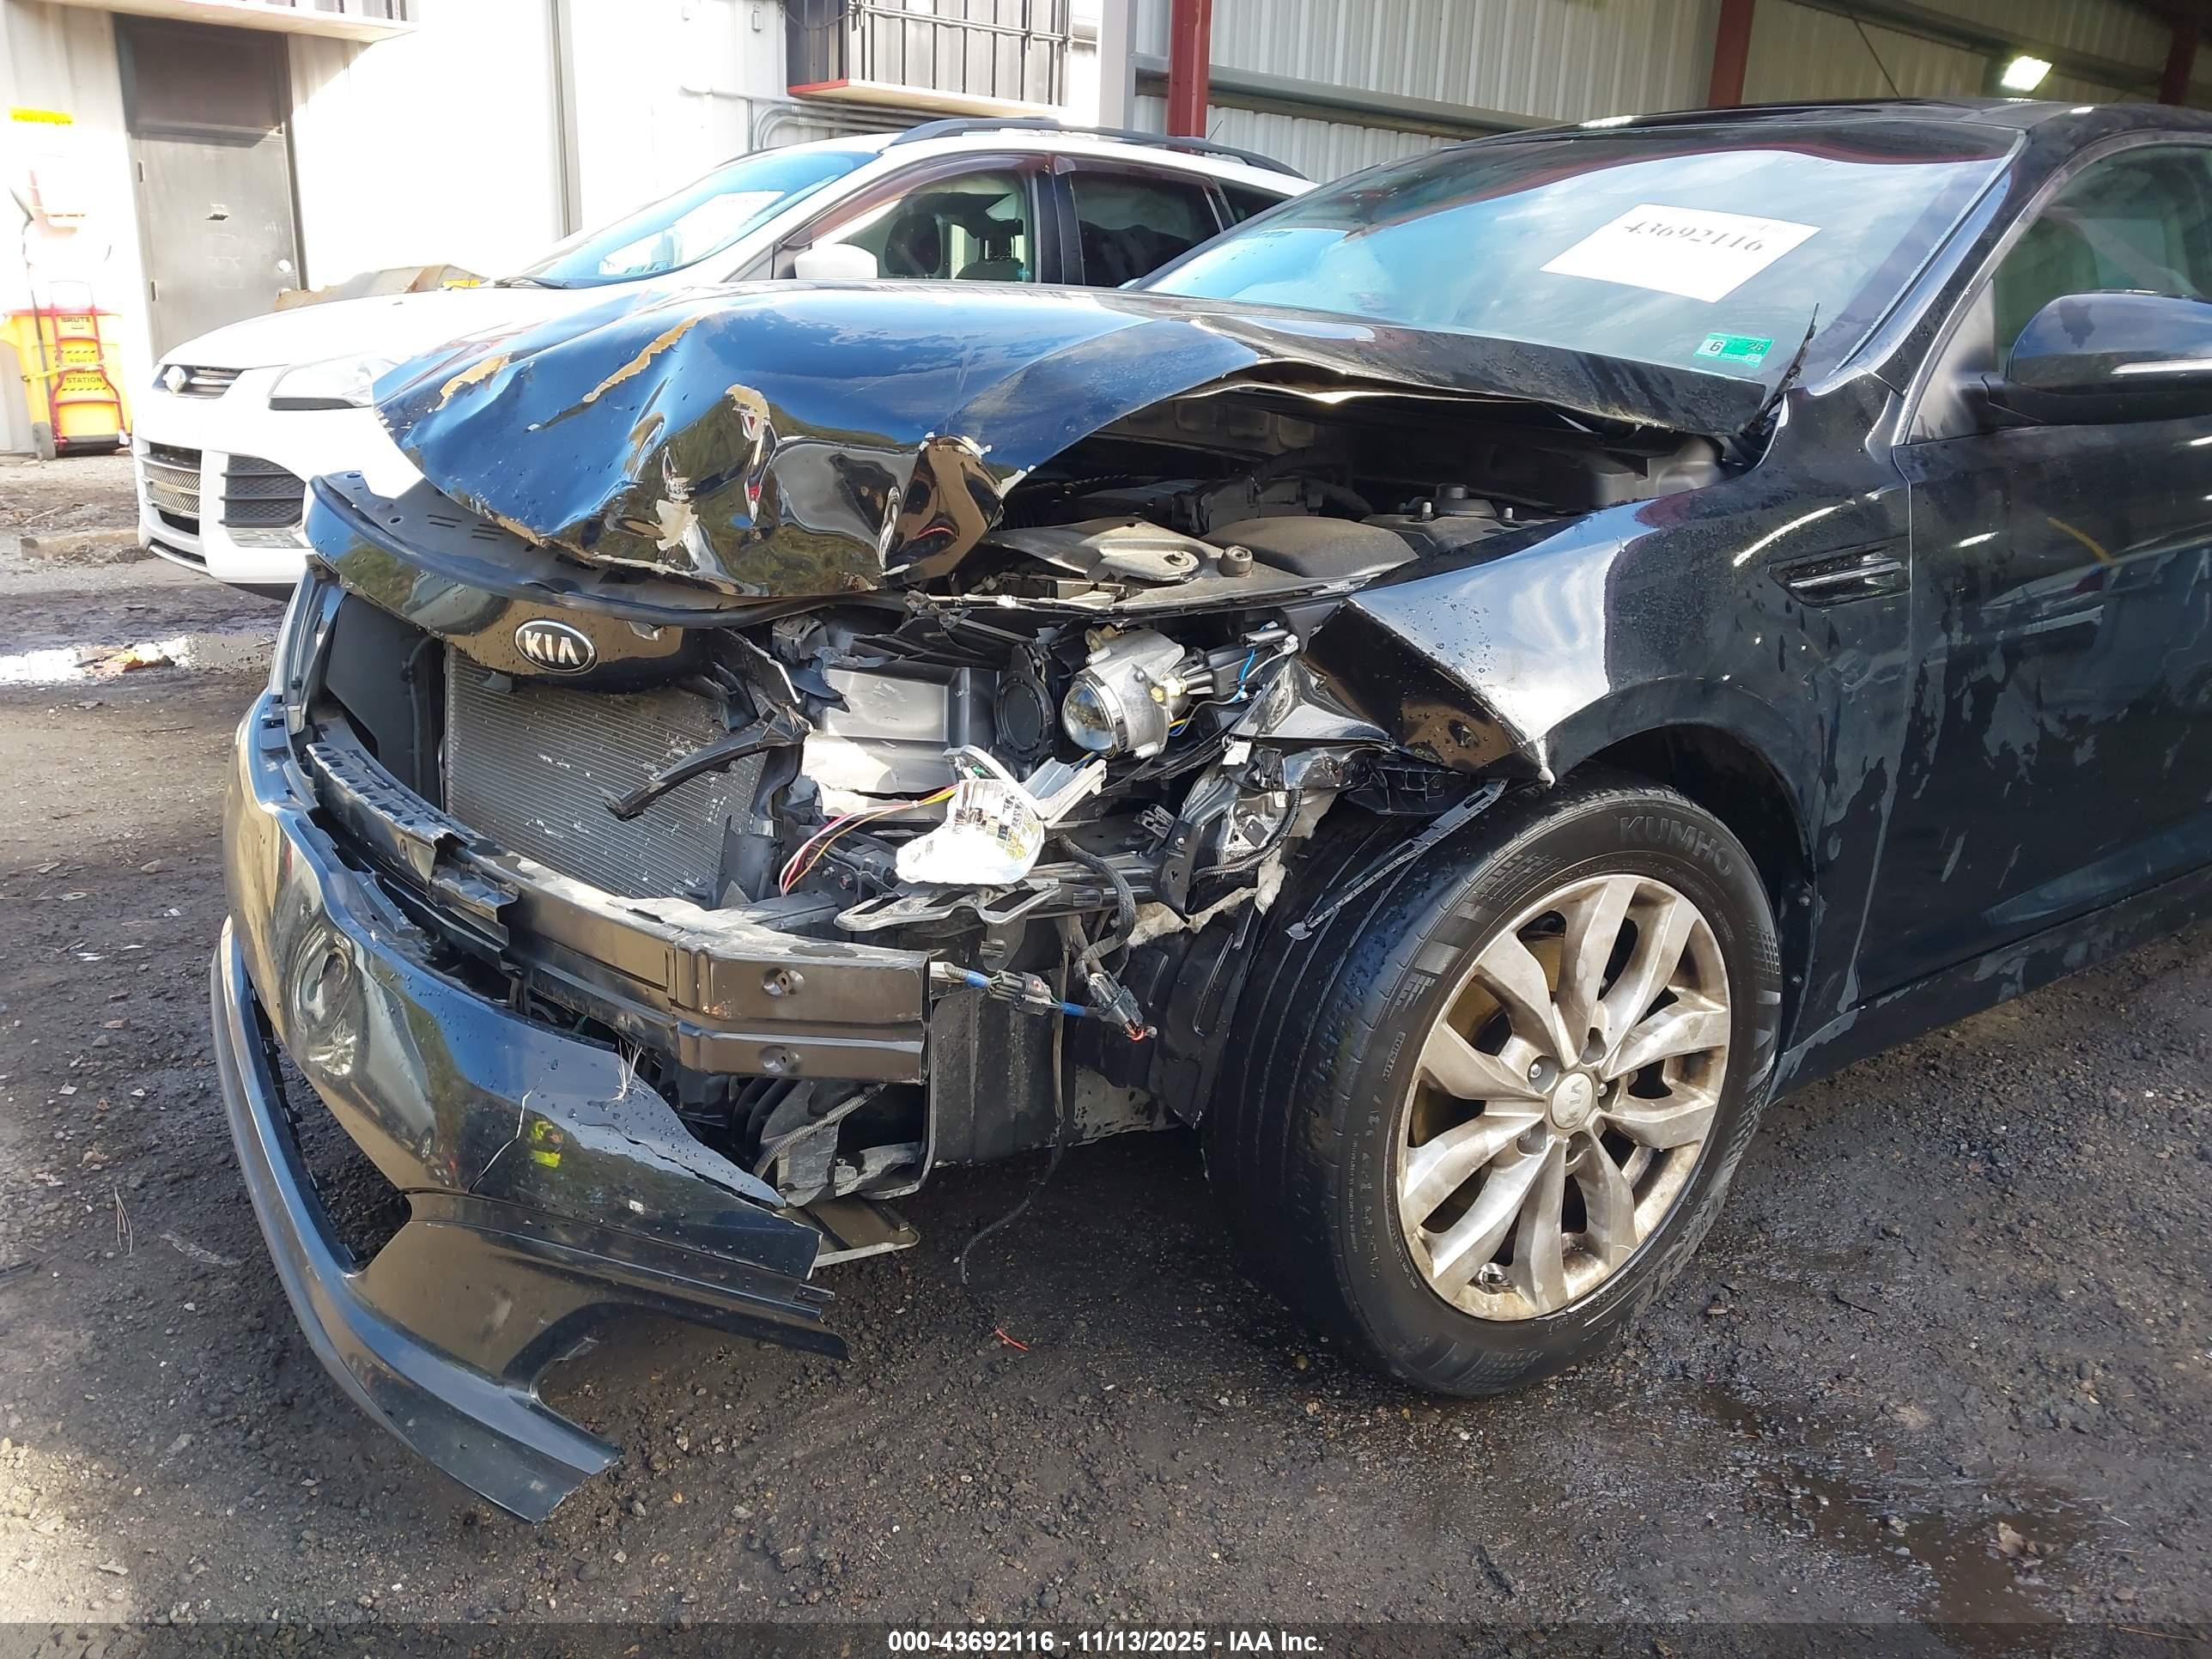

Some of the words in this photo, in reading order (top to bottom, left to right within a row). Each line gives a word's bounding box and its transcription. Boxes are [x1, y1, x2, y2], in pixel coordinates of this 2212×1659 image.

[1624, 221, 1765, 252] 43692116
[1709, 341, 1723, 352] 6
[525, 629, 580, 665] KIA
[1620, 816, 1733, 877] KUMHO
[1565, 1079, 1583, 1124] KIA
